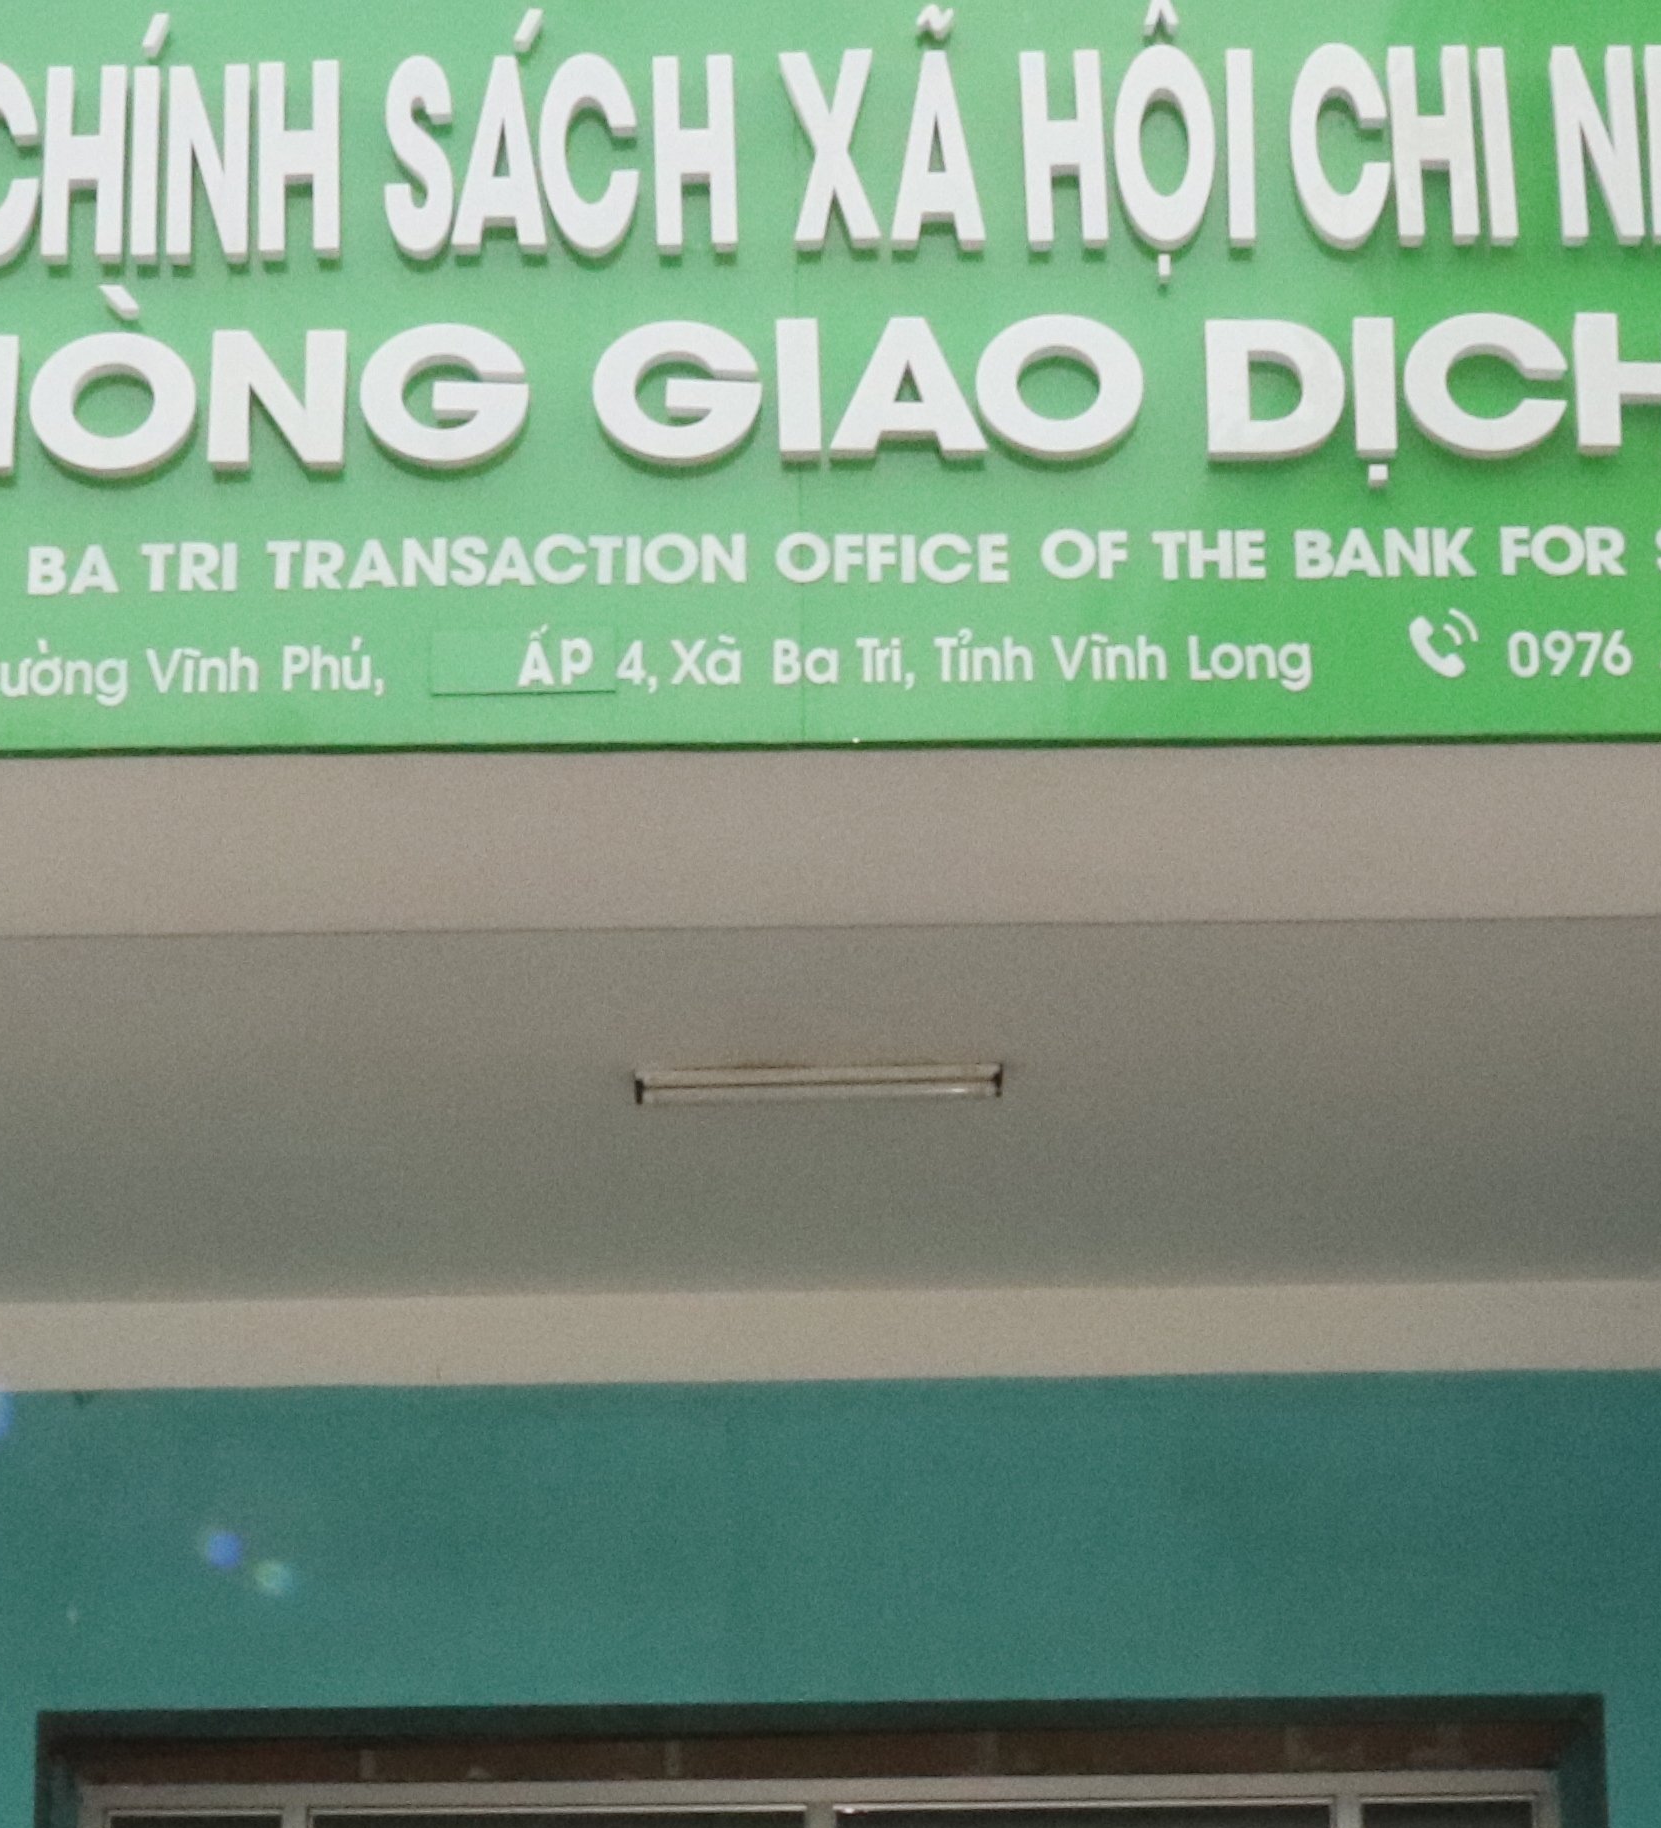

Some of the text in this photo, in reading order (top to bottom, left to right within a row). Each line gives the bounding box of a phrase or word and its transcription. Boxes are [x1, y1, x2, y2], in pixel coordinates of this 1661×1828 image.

[384, 8, 736, 259] SÁCH
[780, 4, 987, 251] XÃ
[1019, 0, 1257, 284] HỘI
[1290, 43, 1520, 249] CHI
[592, 313, 1145, 468] GIAO
[27, 545, 119, 595] BA
[141, 542, 238, 593] TRI
[266, 532, 746, 590] TRANSACTION
[775, 531, 1009, 584] OFFICE
[1041, 529, 1127, 580] OF
[1152, 529, 1266, 580] THE
[1294, 526, 1477, 579] BANK
[1500, 525, 1626, 577] FOR
[146, 646, 259, 694] Vĩnh
[282, 636, 385, 697] Phú,
[772, 638, 838, 686] Ba
[856, 635, 916, 691] Tri,
[935, 628, 1034, 683] Tỉnh
[1052, 633, 1167, 682] Vĩnh
[1188, 635, 1313, 692] Long
[1508, 629, 1633, 679] 0976
